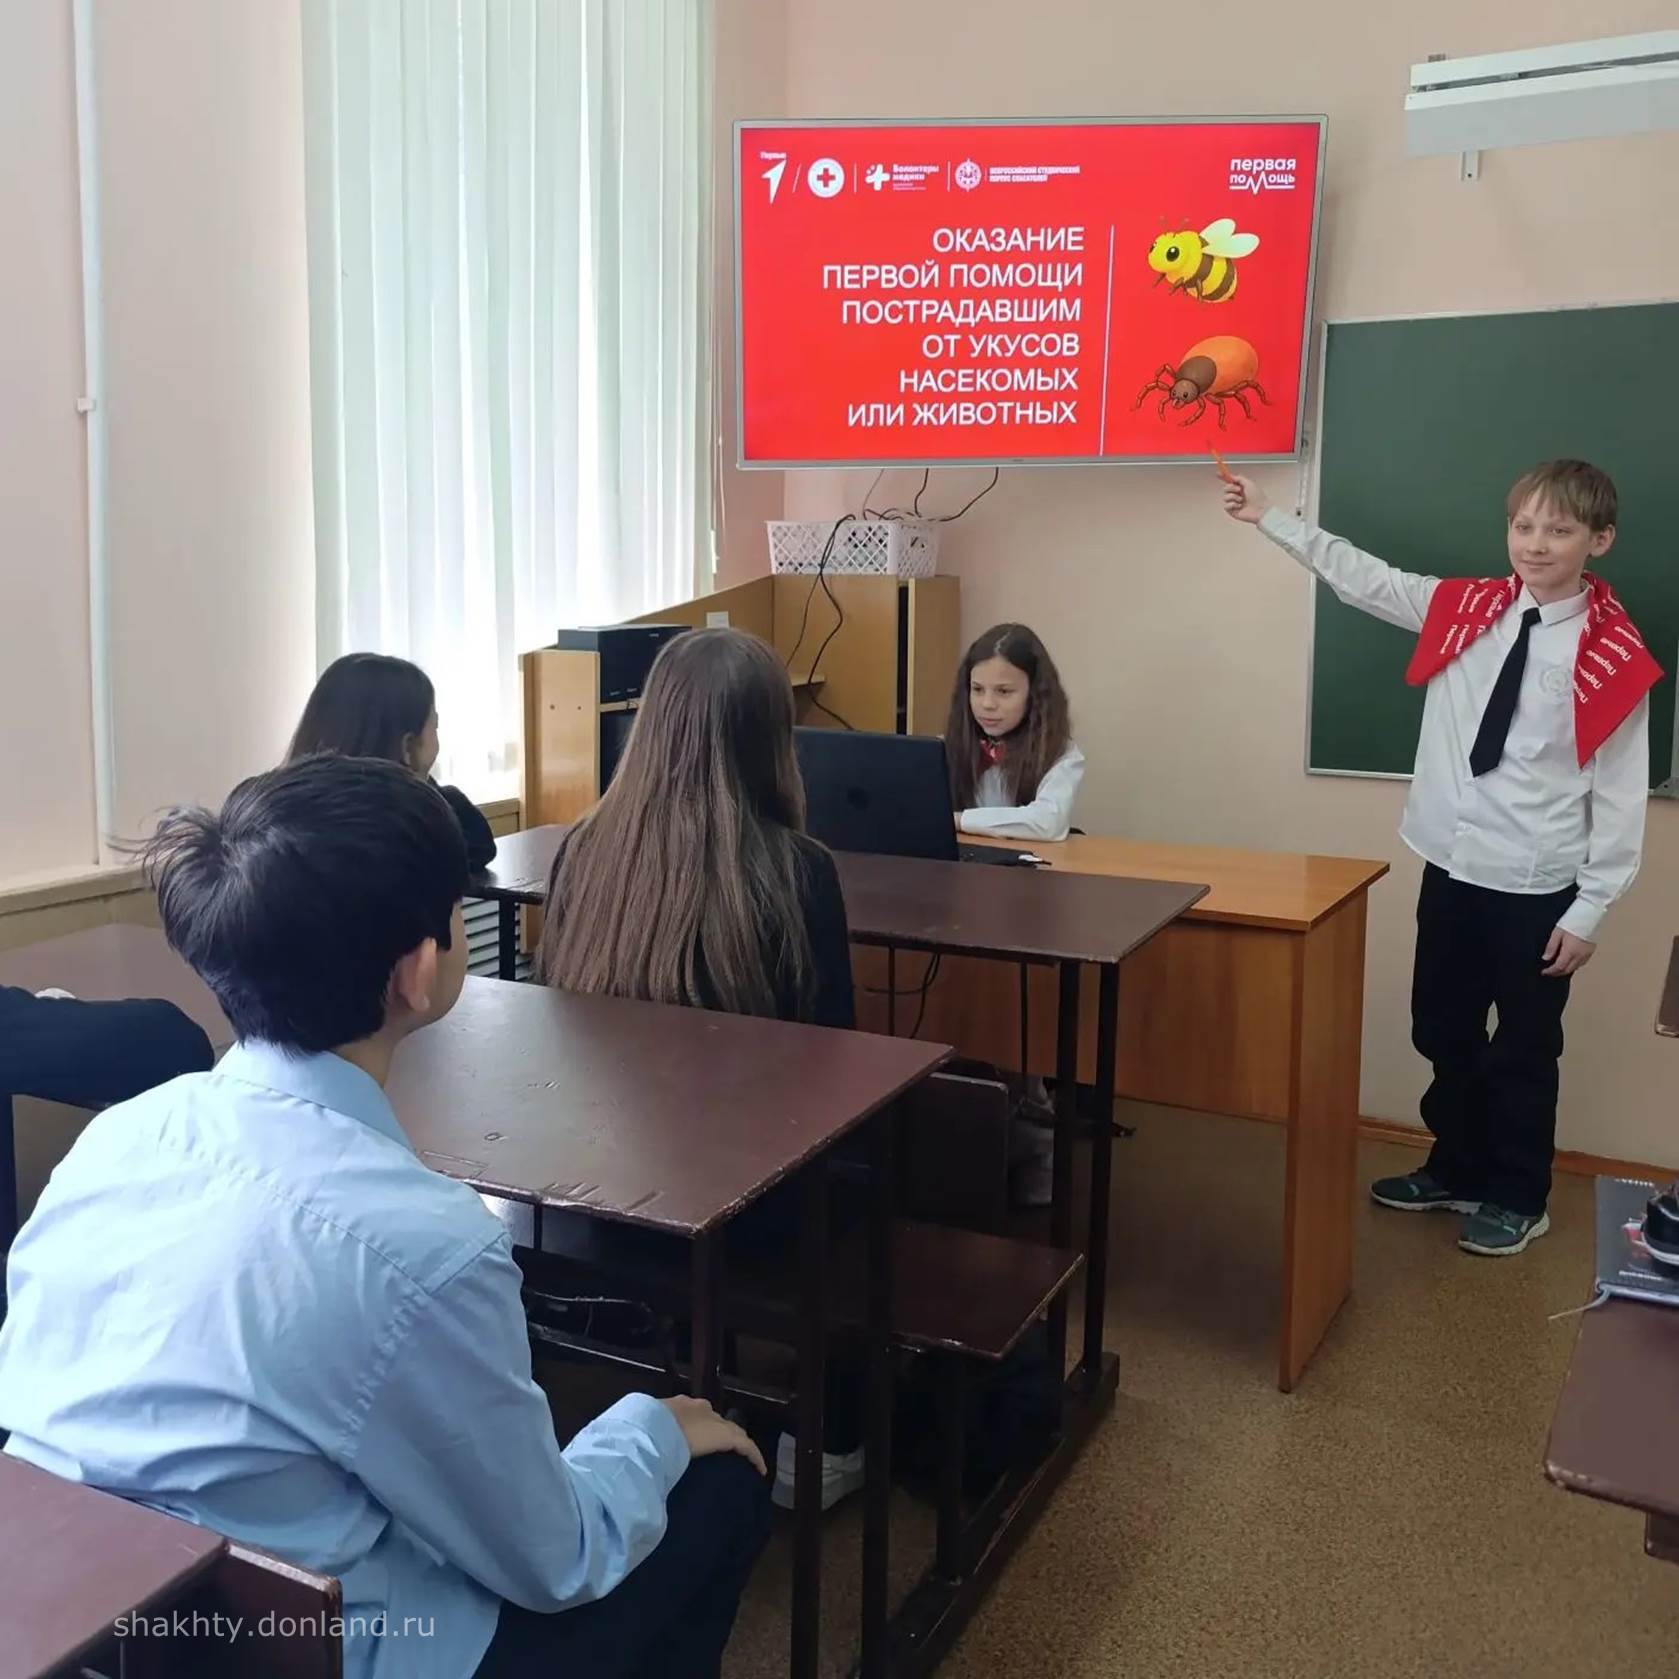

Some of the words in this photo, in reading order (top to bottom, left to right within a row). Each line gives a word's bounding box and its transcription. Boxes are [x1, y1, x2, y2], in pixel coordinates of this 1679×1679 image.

[1230, 158, 1296, 174] первая
[932, 227, 1084, 252] ОКАЗАНИЕ
[823, 260, 939, 288] ПЕРВОЙ
[950, 263, 1083, 291] ПОМОЩИ
[842, 299, 1081, 326] ПОСТРАДАВШИМ
[922, 335, 961, 358] ОТ
[969, 333, 1080, 357] УКУСОВ
[899, 368, 1079, 392] НАСЕКОМЫХ
[848, 404, 904, 427] ИЛИ
[912, 401, 1077, 426] ЖИВОТНЫХ
